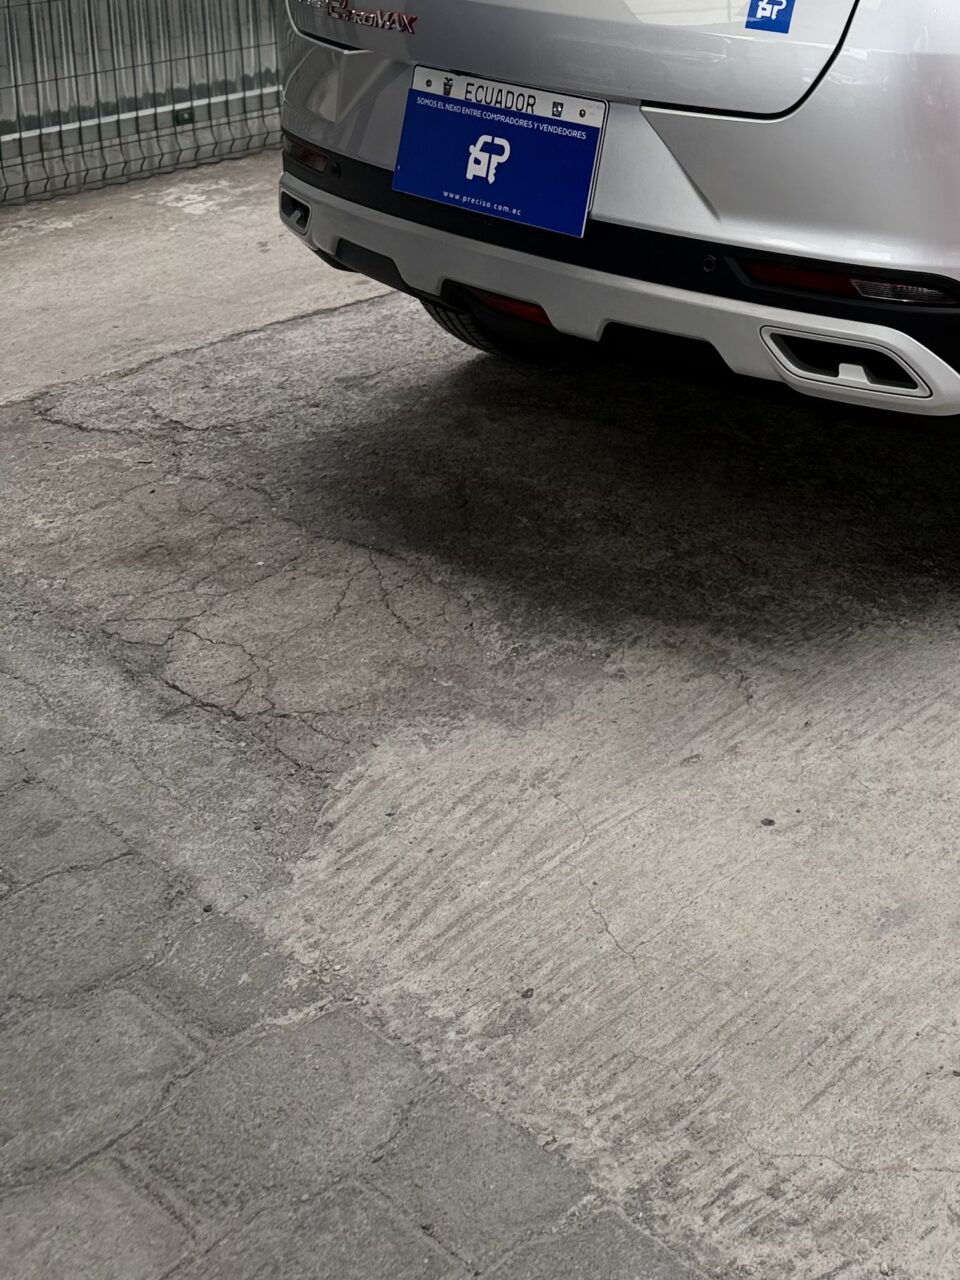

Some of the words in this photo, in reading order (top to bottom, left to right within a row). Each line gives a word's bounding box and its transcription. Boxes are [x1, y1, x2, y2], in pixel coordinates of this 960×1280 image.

[464, 82, 537, 114] ECUADOR
[416, 96, 437, 108] SOMOS
[437, 101, 445, 110] EL
[445, 103, 461, 113] NEXO
[461, 106, 482, 118] ENTRE
[482, 111, 533, 129] COMPRADORES
[533, 121, 539, 129] Y
[539, 122, 587, 140] VENDEDORES
[442, 190, 522, 216] www.preciso.com.ec
